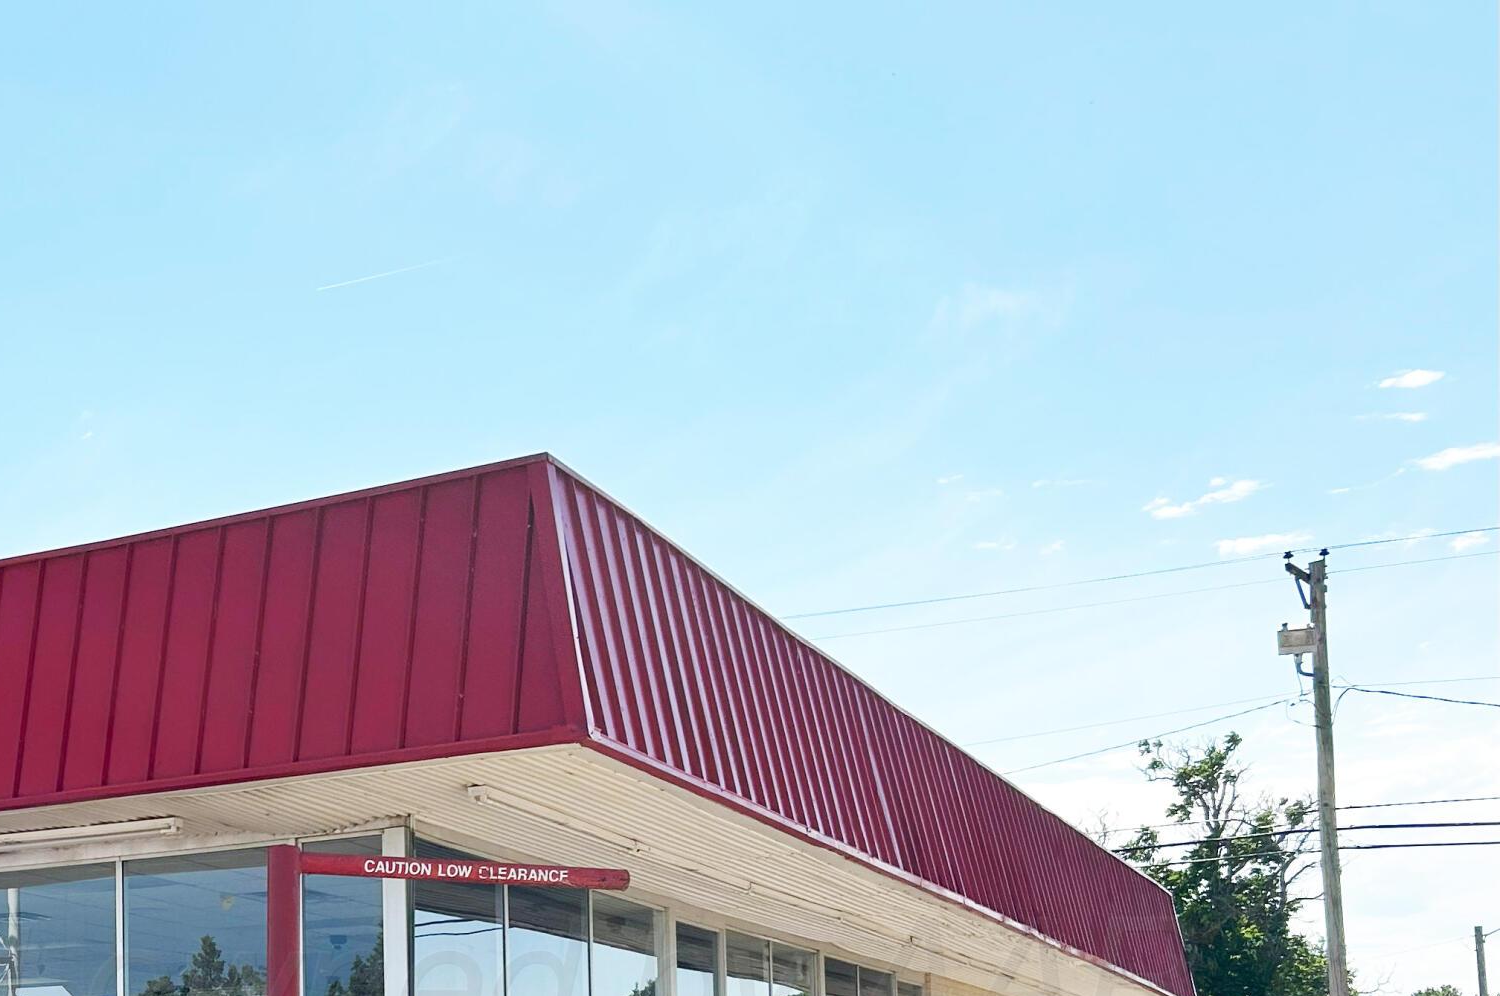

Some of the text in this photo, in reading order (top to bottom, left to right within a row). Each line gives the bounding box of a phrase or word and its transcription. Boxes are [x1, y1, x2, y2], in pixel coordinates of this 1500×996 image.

[364, 860, 568, 882] CAUTION LOW CLEARANCE
